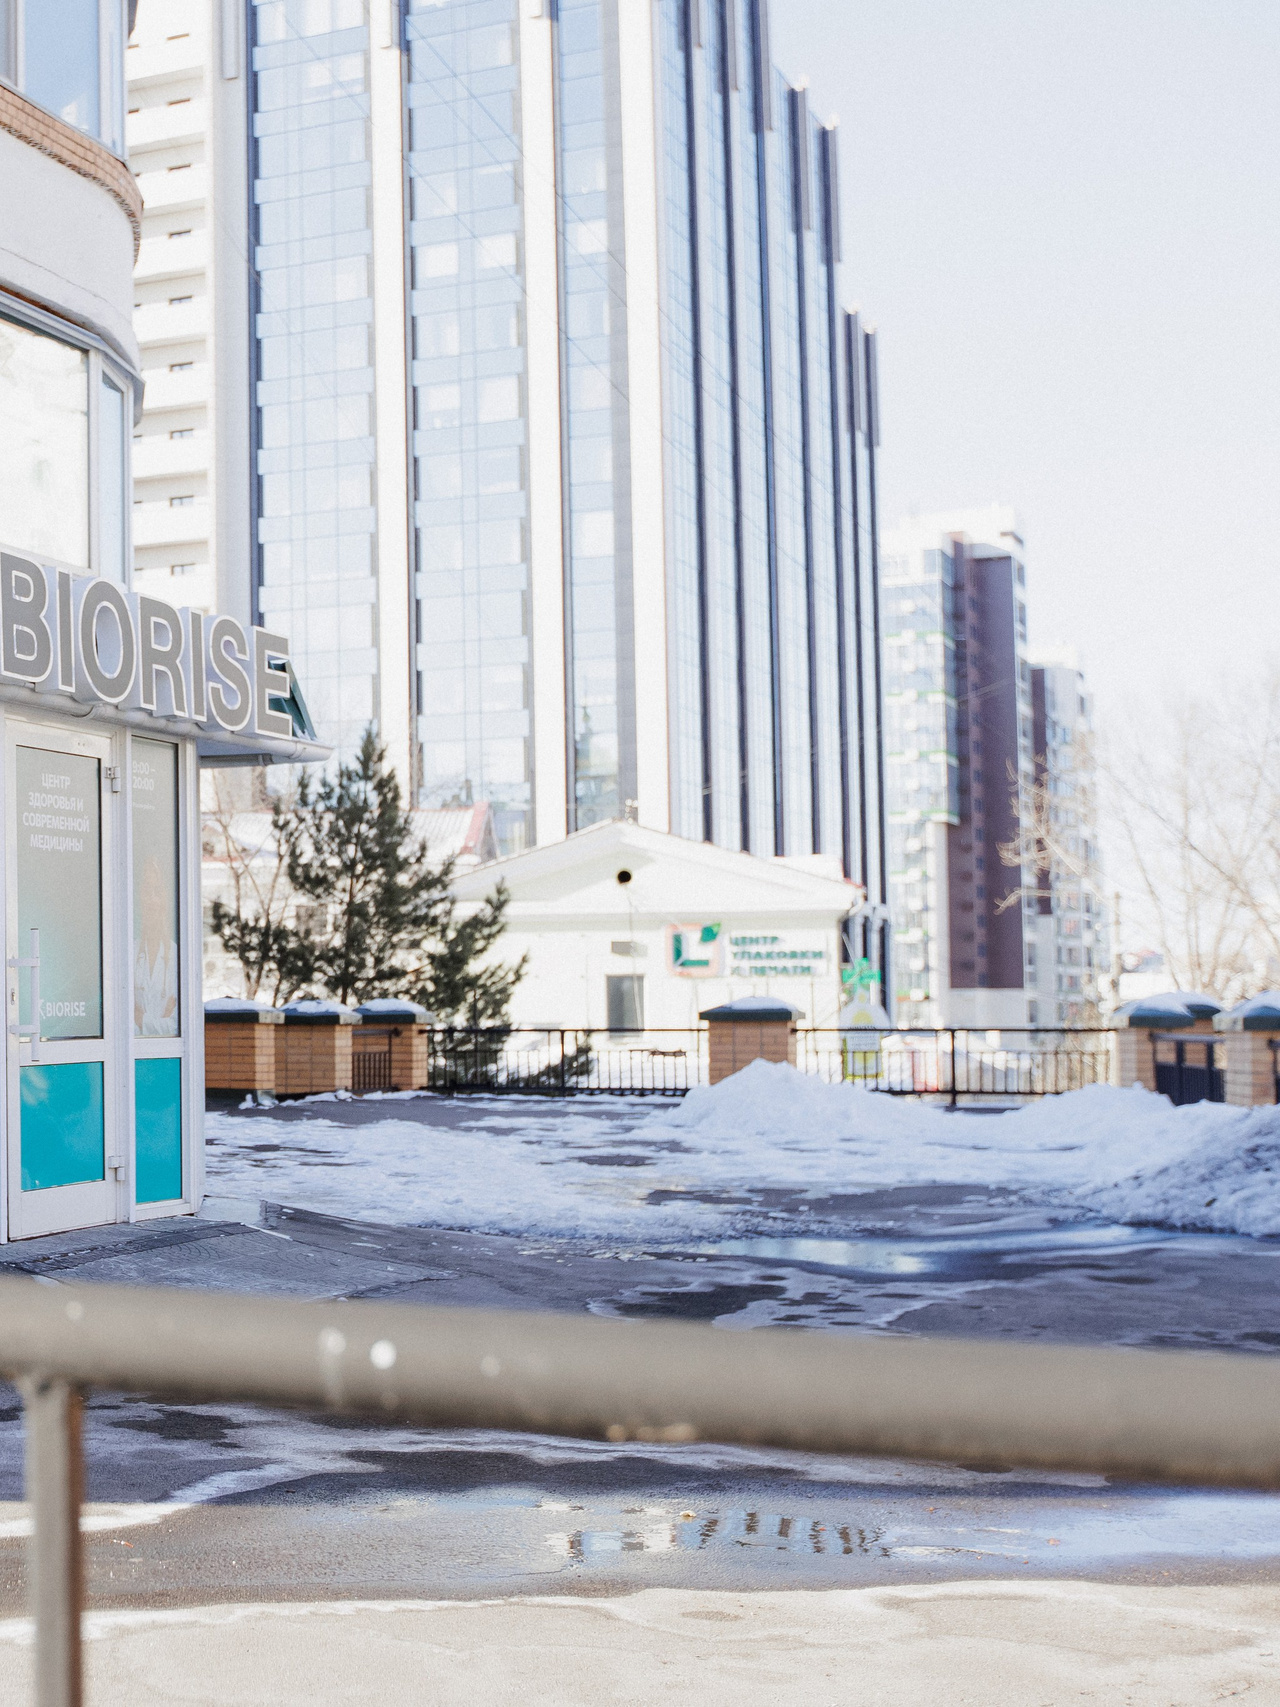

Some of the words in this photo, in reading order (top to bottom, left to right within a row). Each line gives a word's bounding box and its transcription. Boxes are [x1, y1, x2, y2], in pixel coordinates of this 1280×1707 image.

[41, 773, 71, 790] ЦЕНТР
[132, 776, 155, 791] 20:00
[28, 791, 76, 811] ЗДОРОВЬЯ
[77, 797, 84, 812] И
[22, 812, 90, 833] СОВРЕМЕННОЙ
[30, 833, 84, 853] МЕДИЦИНЫ
[730, 936, 780, 947] ЦЕНТР
[732, 951, 823, 960] УПАКОВКИ
[749, 966, 811, 976] ПЕЧАТИ
[46, 1001, 86, 1017] BIORISE
